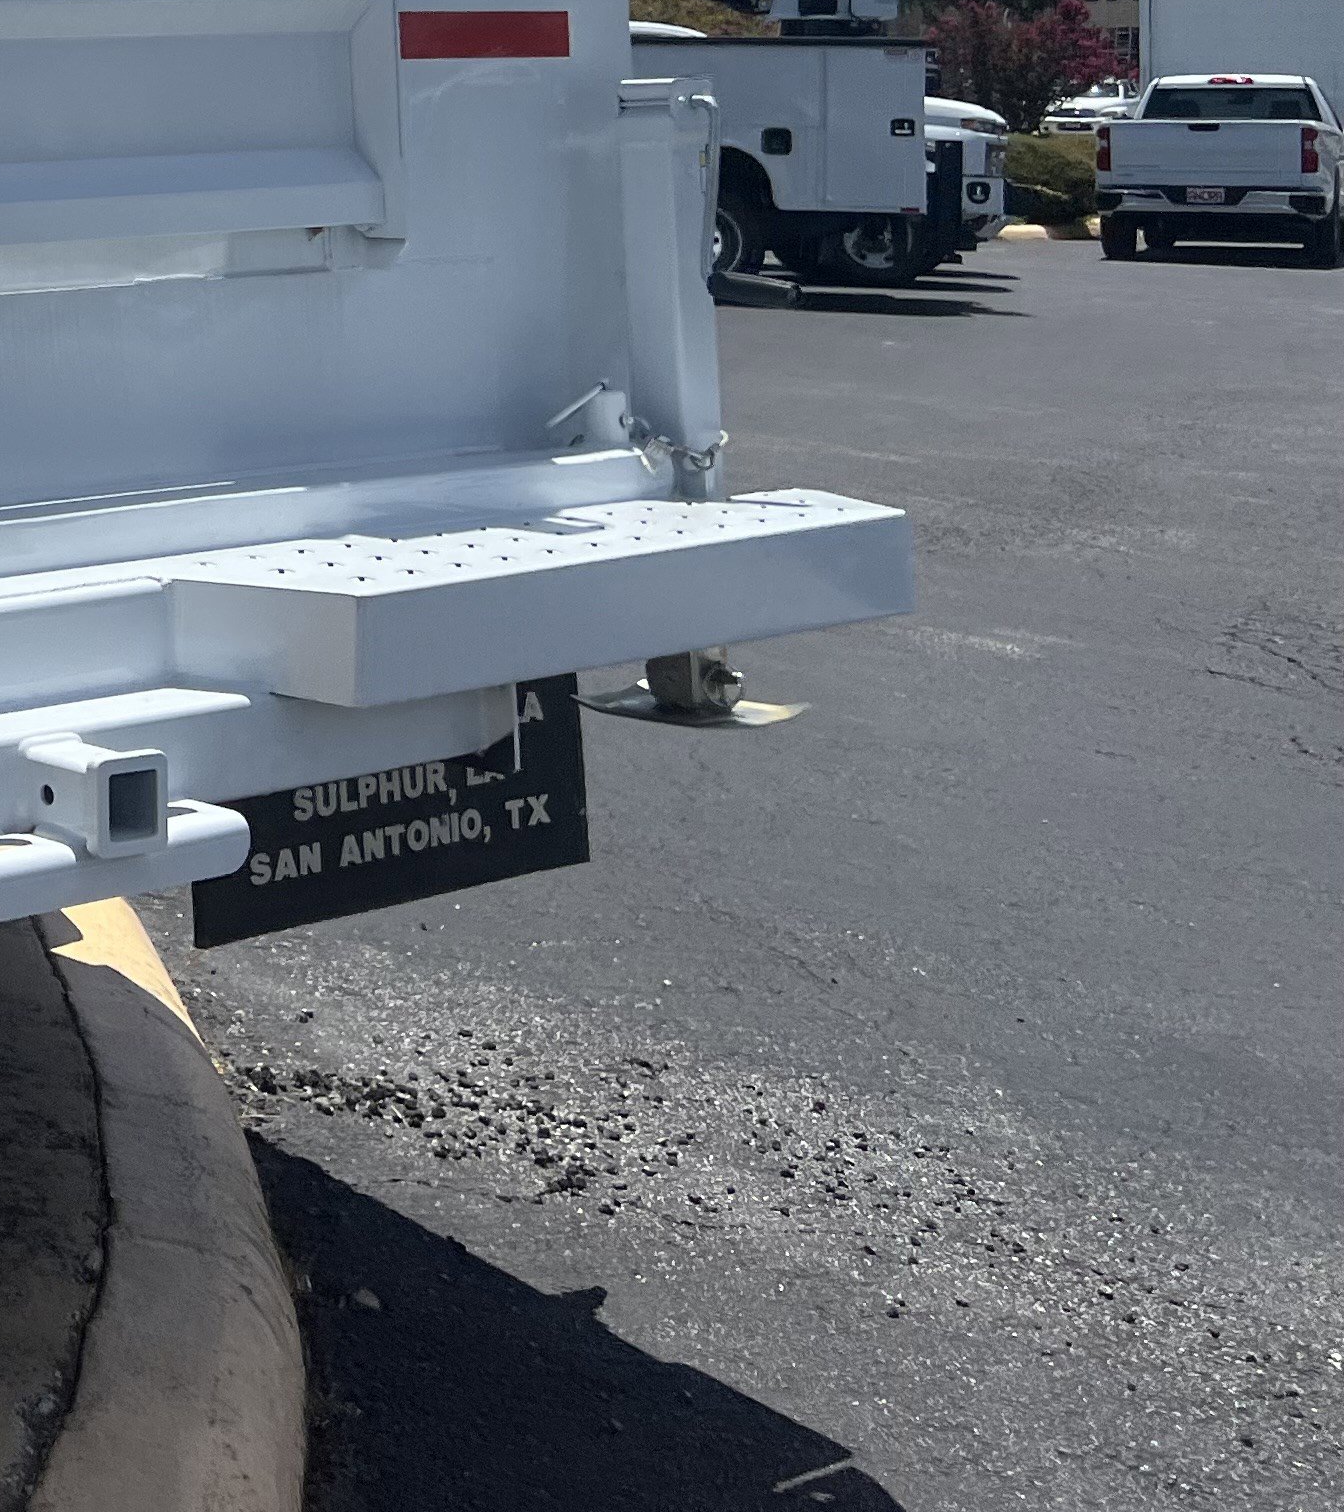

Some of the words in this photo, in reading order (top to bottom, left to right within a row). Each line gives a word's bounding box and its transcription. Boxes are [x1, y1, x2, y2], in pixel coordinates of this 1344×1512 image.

[294, 762, 457, 821] SULPHUR,
[250, 843, 322, 886] SAN
[339, 809, 492, 868] ANTONIO,
[504, 793, 552, 829] TX
